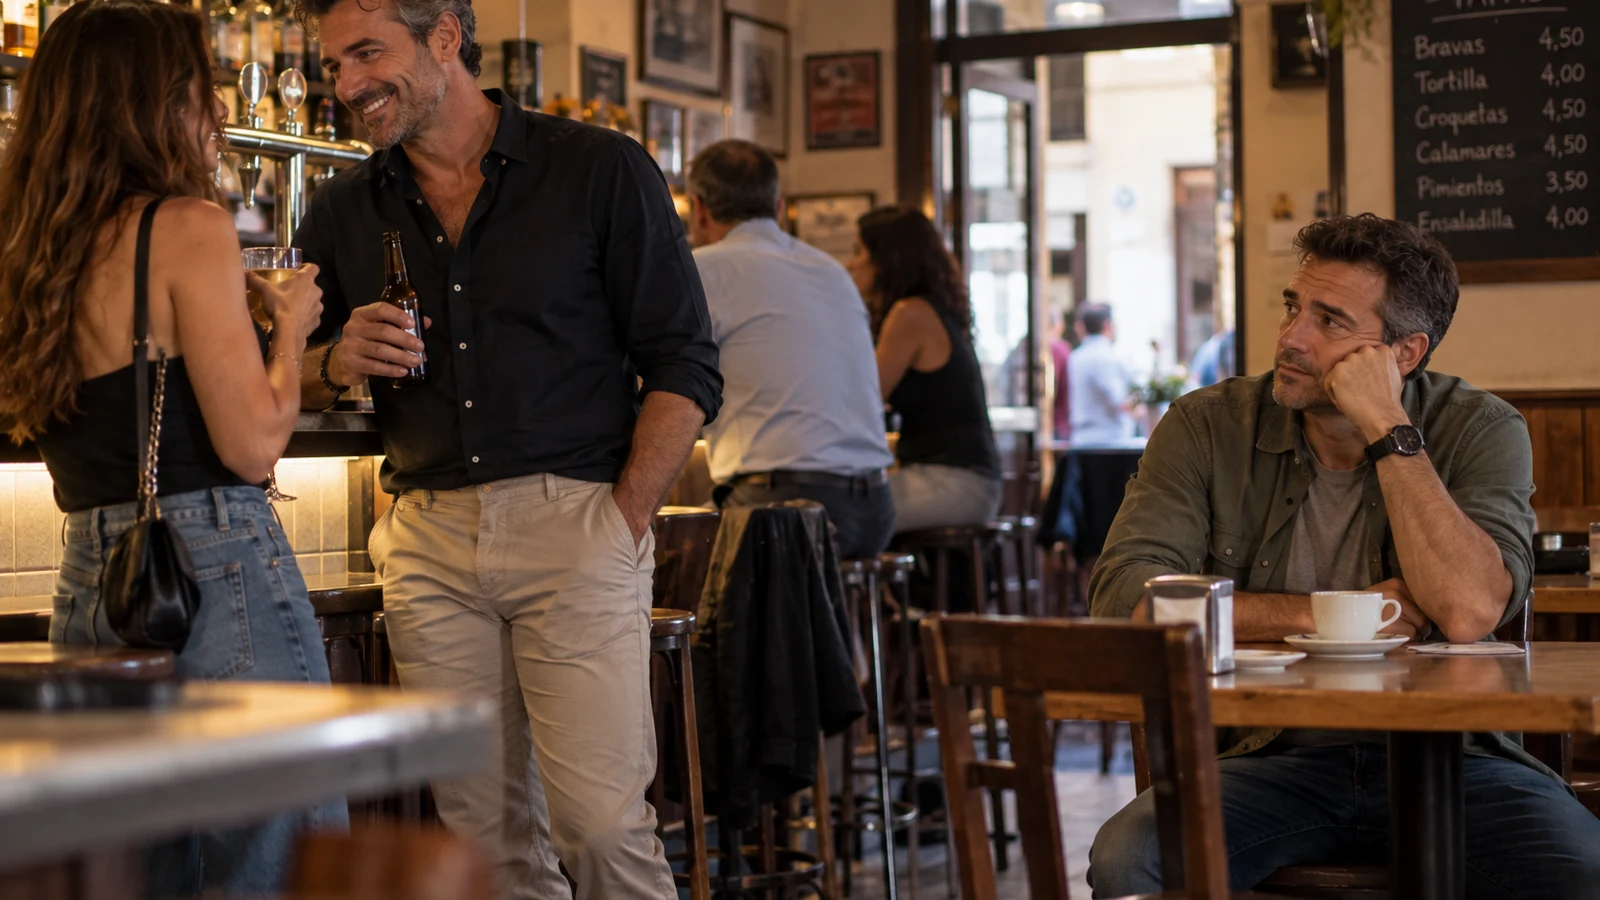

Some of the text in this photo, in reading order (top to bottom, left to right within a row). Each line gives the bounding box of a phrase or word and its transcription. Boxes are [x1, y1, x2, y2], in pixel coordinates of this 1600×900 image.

[1414, 26, 1585, 60] Bravas 4,50
[1413, 62, 1586, 94] Tortilla 4,00
[1414, 97, 1586, 136] Croquetas 4,50
[1415, 134, 1587, 164] Calamares 4,50
[1417, 170, 1588, 199] Pimientos 3,50
[1417, 204, 1589, 232] Ensaladilla 4,00
